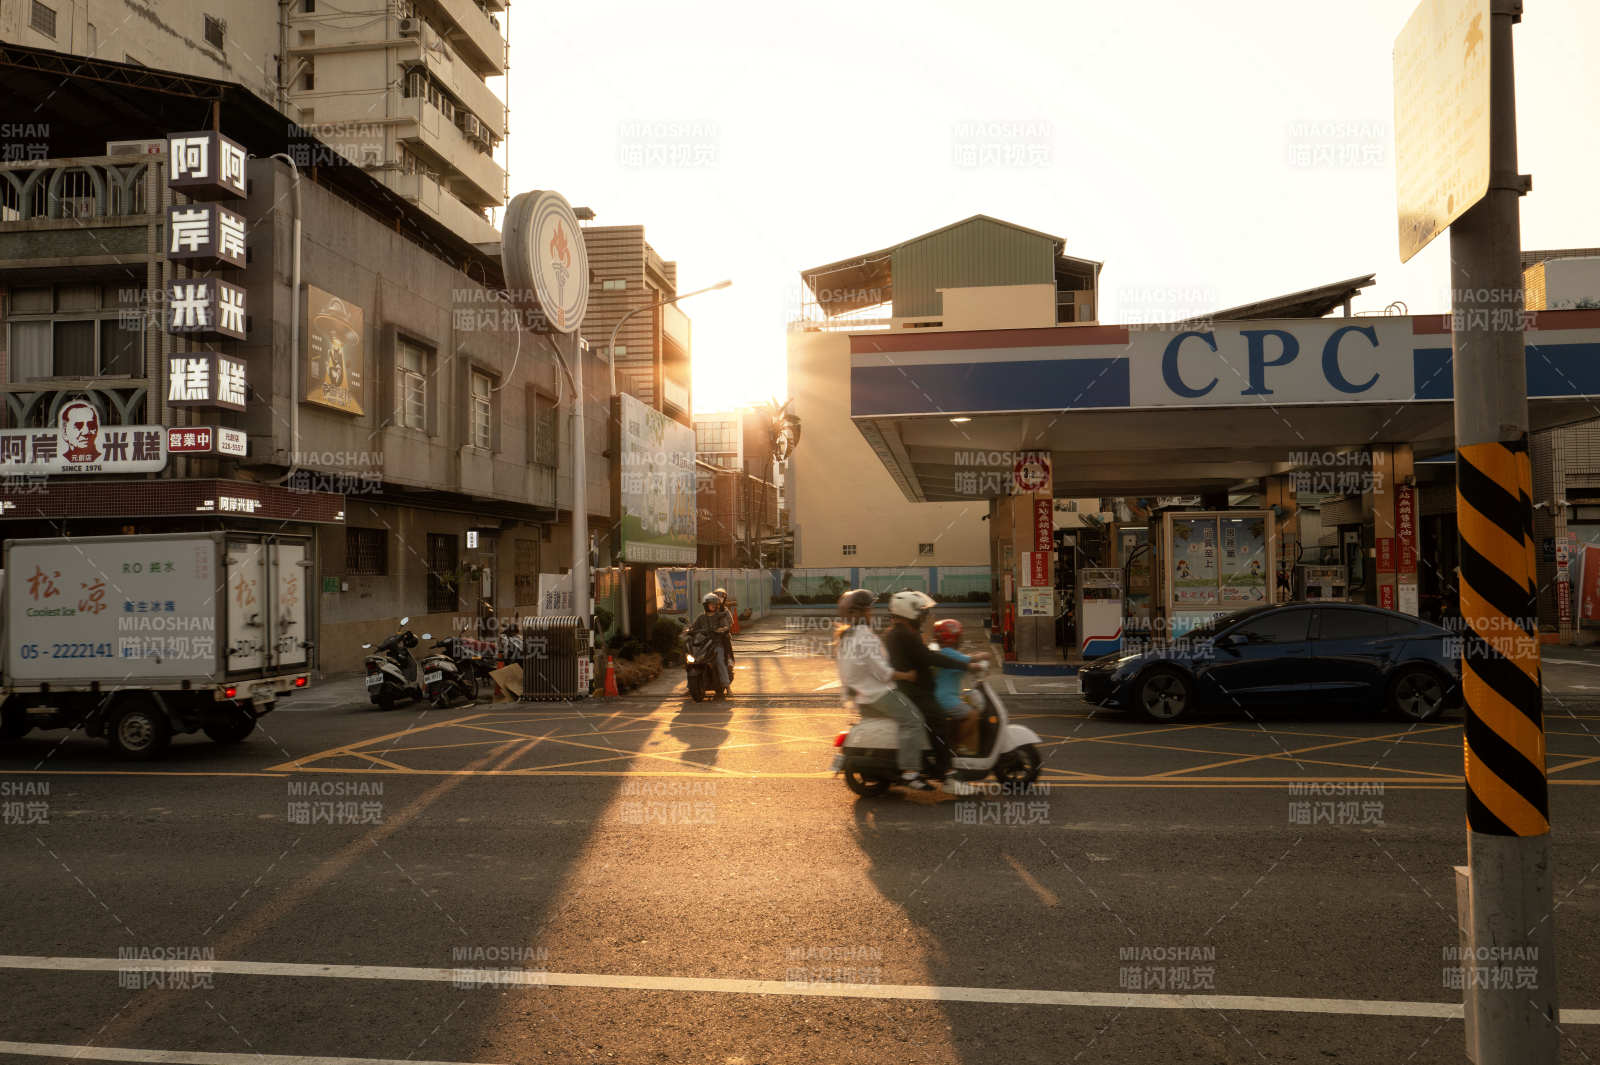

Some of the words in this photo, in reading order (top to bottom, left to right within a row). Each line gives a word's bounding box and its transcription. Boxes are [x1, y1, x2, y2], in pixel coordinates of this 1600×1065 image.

[168, 135, 209, 401] 阿岸米糕
[218, 138, 246, 407] 阿岸米糕
[1162, 325, 1381, 398] CPC
[0, 433, 58, 464] 阿岸
[103, 431, 160, 462] 米糕
[169, 432, 209, 448] 營業中
[218, 496, 255, 513] 阿岸米糕
[122, 562, 143, 574] RO
[26, 607, 59, 617] Coolest
[62, 607, 76, 617] Ice
